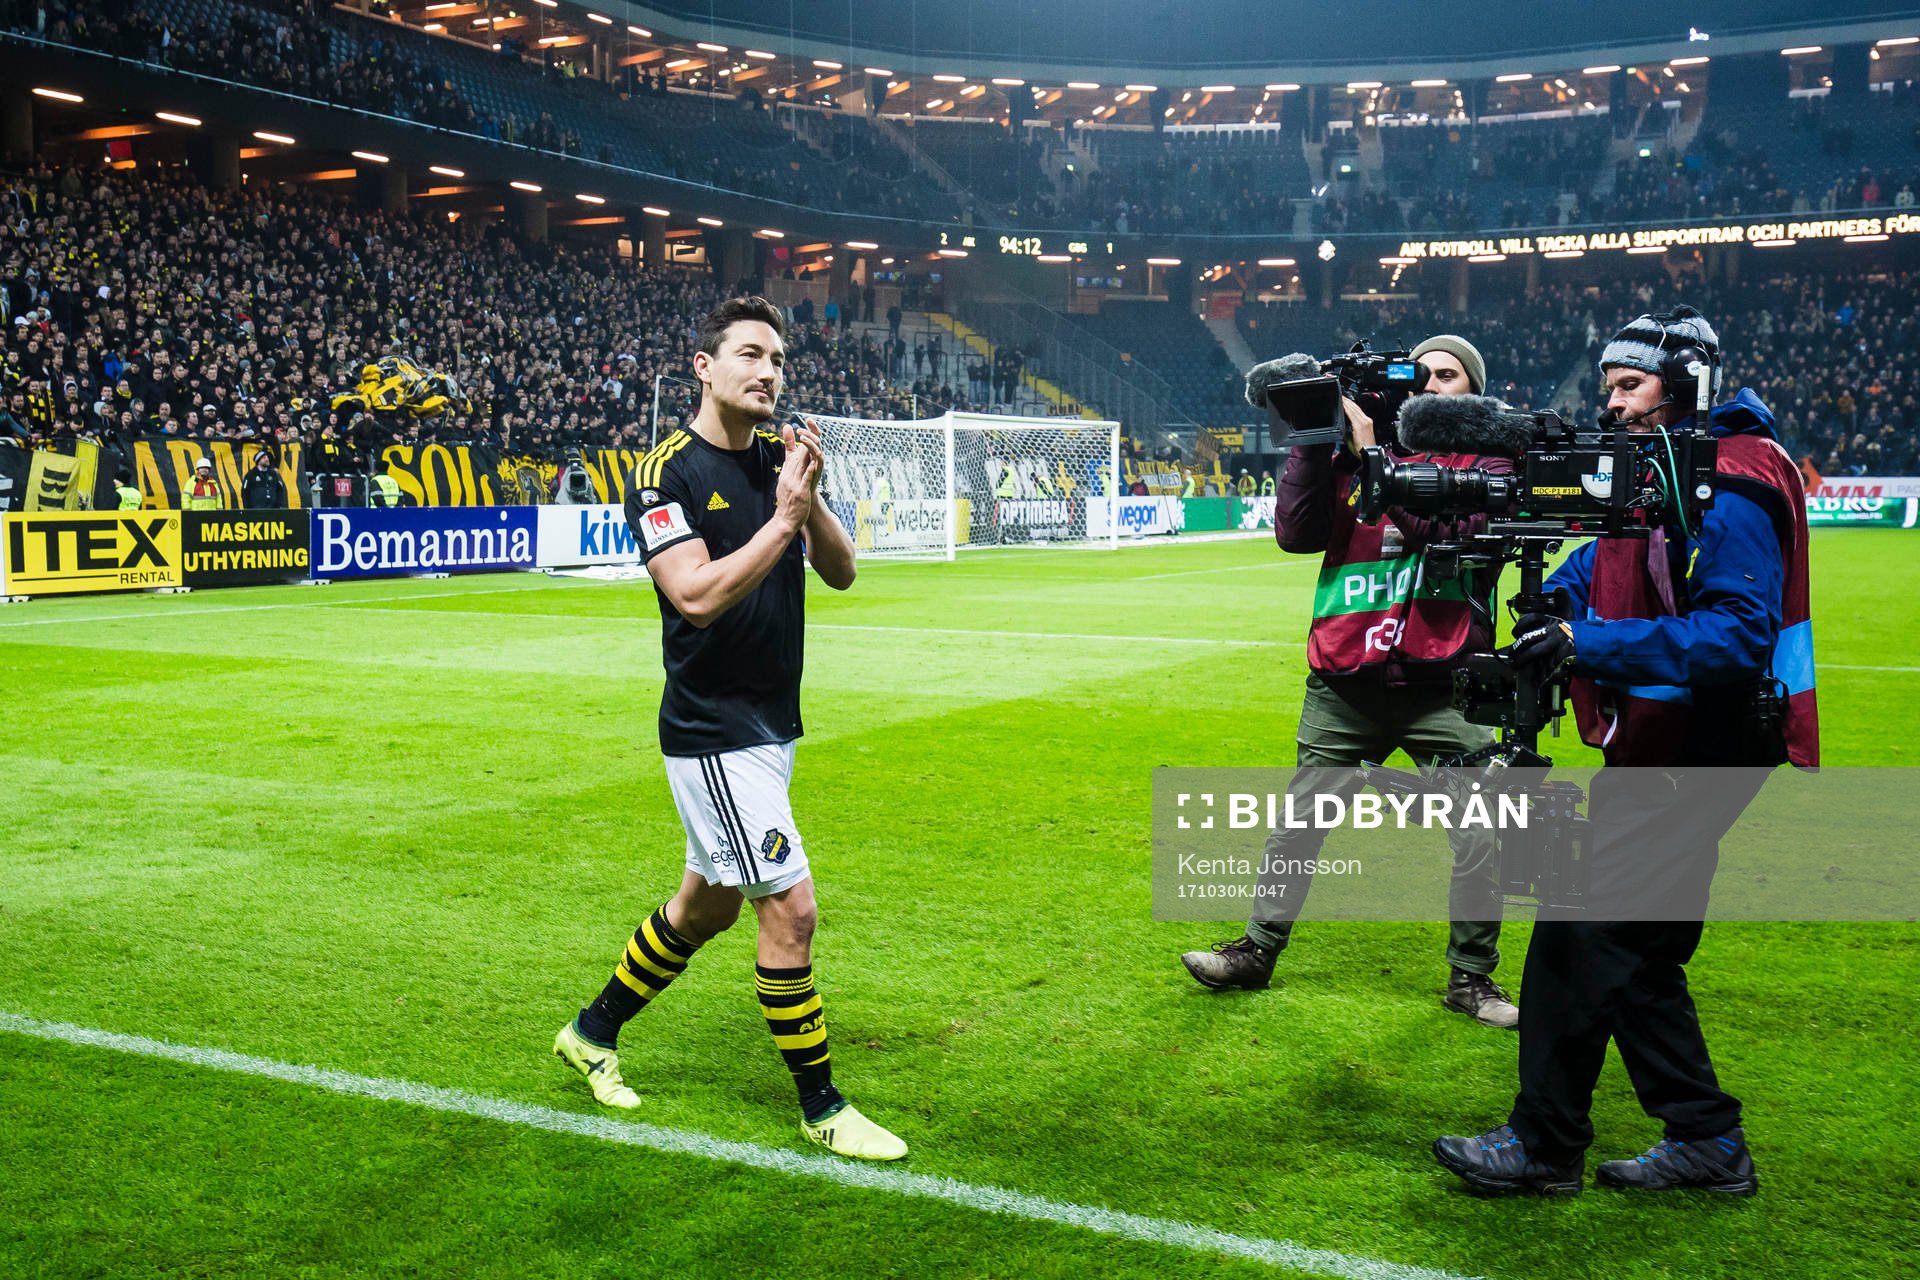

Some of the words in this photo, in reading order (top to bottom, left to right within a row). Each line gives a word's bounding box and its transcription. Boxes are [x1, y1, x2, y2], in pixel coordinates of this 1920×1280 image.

[940, 232, 948, 245] 2
[999, 236, 1042, 256] 94:12
[1106, 242, 1113, 254] 1
[1400, 241, 1428, 258] AIK
[1429, 240, 1498, 257] FOTBOLL
[1500, 237, 1534, 254] VILL
[1536, 234, 1588, 252] TACKA
[1589, 232, 1631, 249] ALLA
[1632, 226, 1744, 248] SUPPORTRAR
[1746, 223, 1785, 241] OCH
[1788, 217, 1882, 239] PARTNERS
[1885, 213, 1920, 233] FÖR
[337, 481, 351, 493] 121
[1533, 487, 1561, 495] HDC-P1
[1562, 487, 1581, 495] #181
[894, 502, 948, 532] weber
[1000, 499, 1068, 526] OPTIMERA
[1107, 501, 1157, 532] wegon
[201, 521, 293, 542] MASKIN-
[317, 510, 533, 572] Bemannia
[9, 518, 169, 573] ITEX
[184, 548, 308, 572] UTHYRNING
[120, 571, 175, 584] RENTAL
